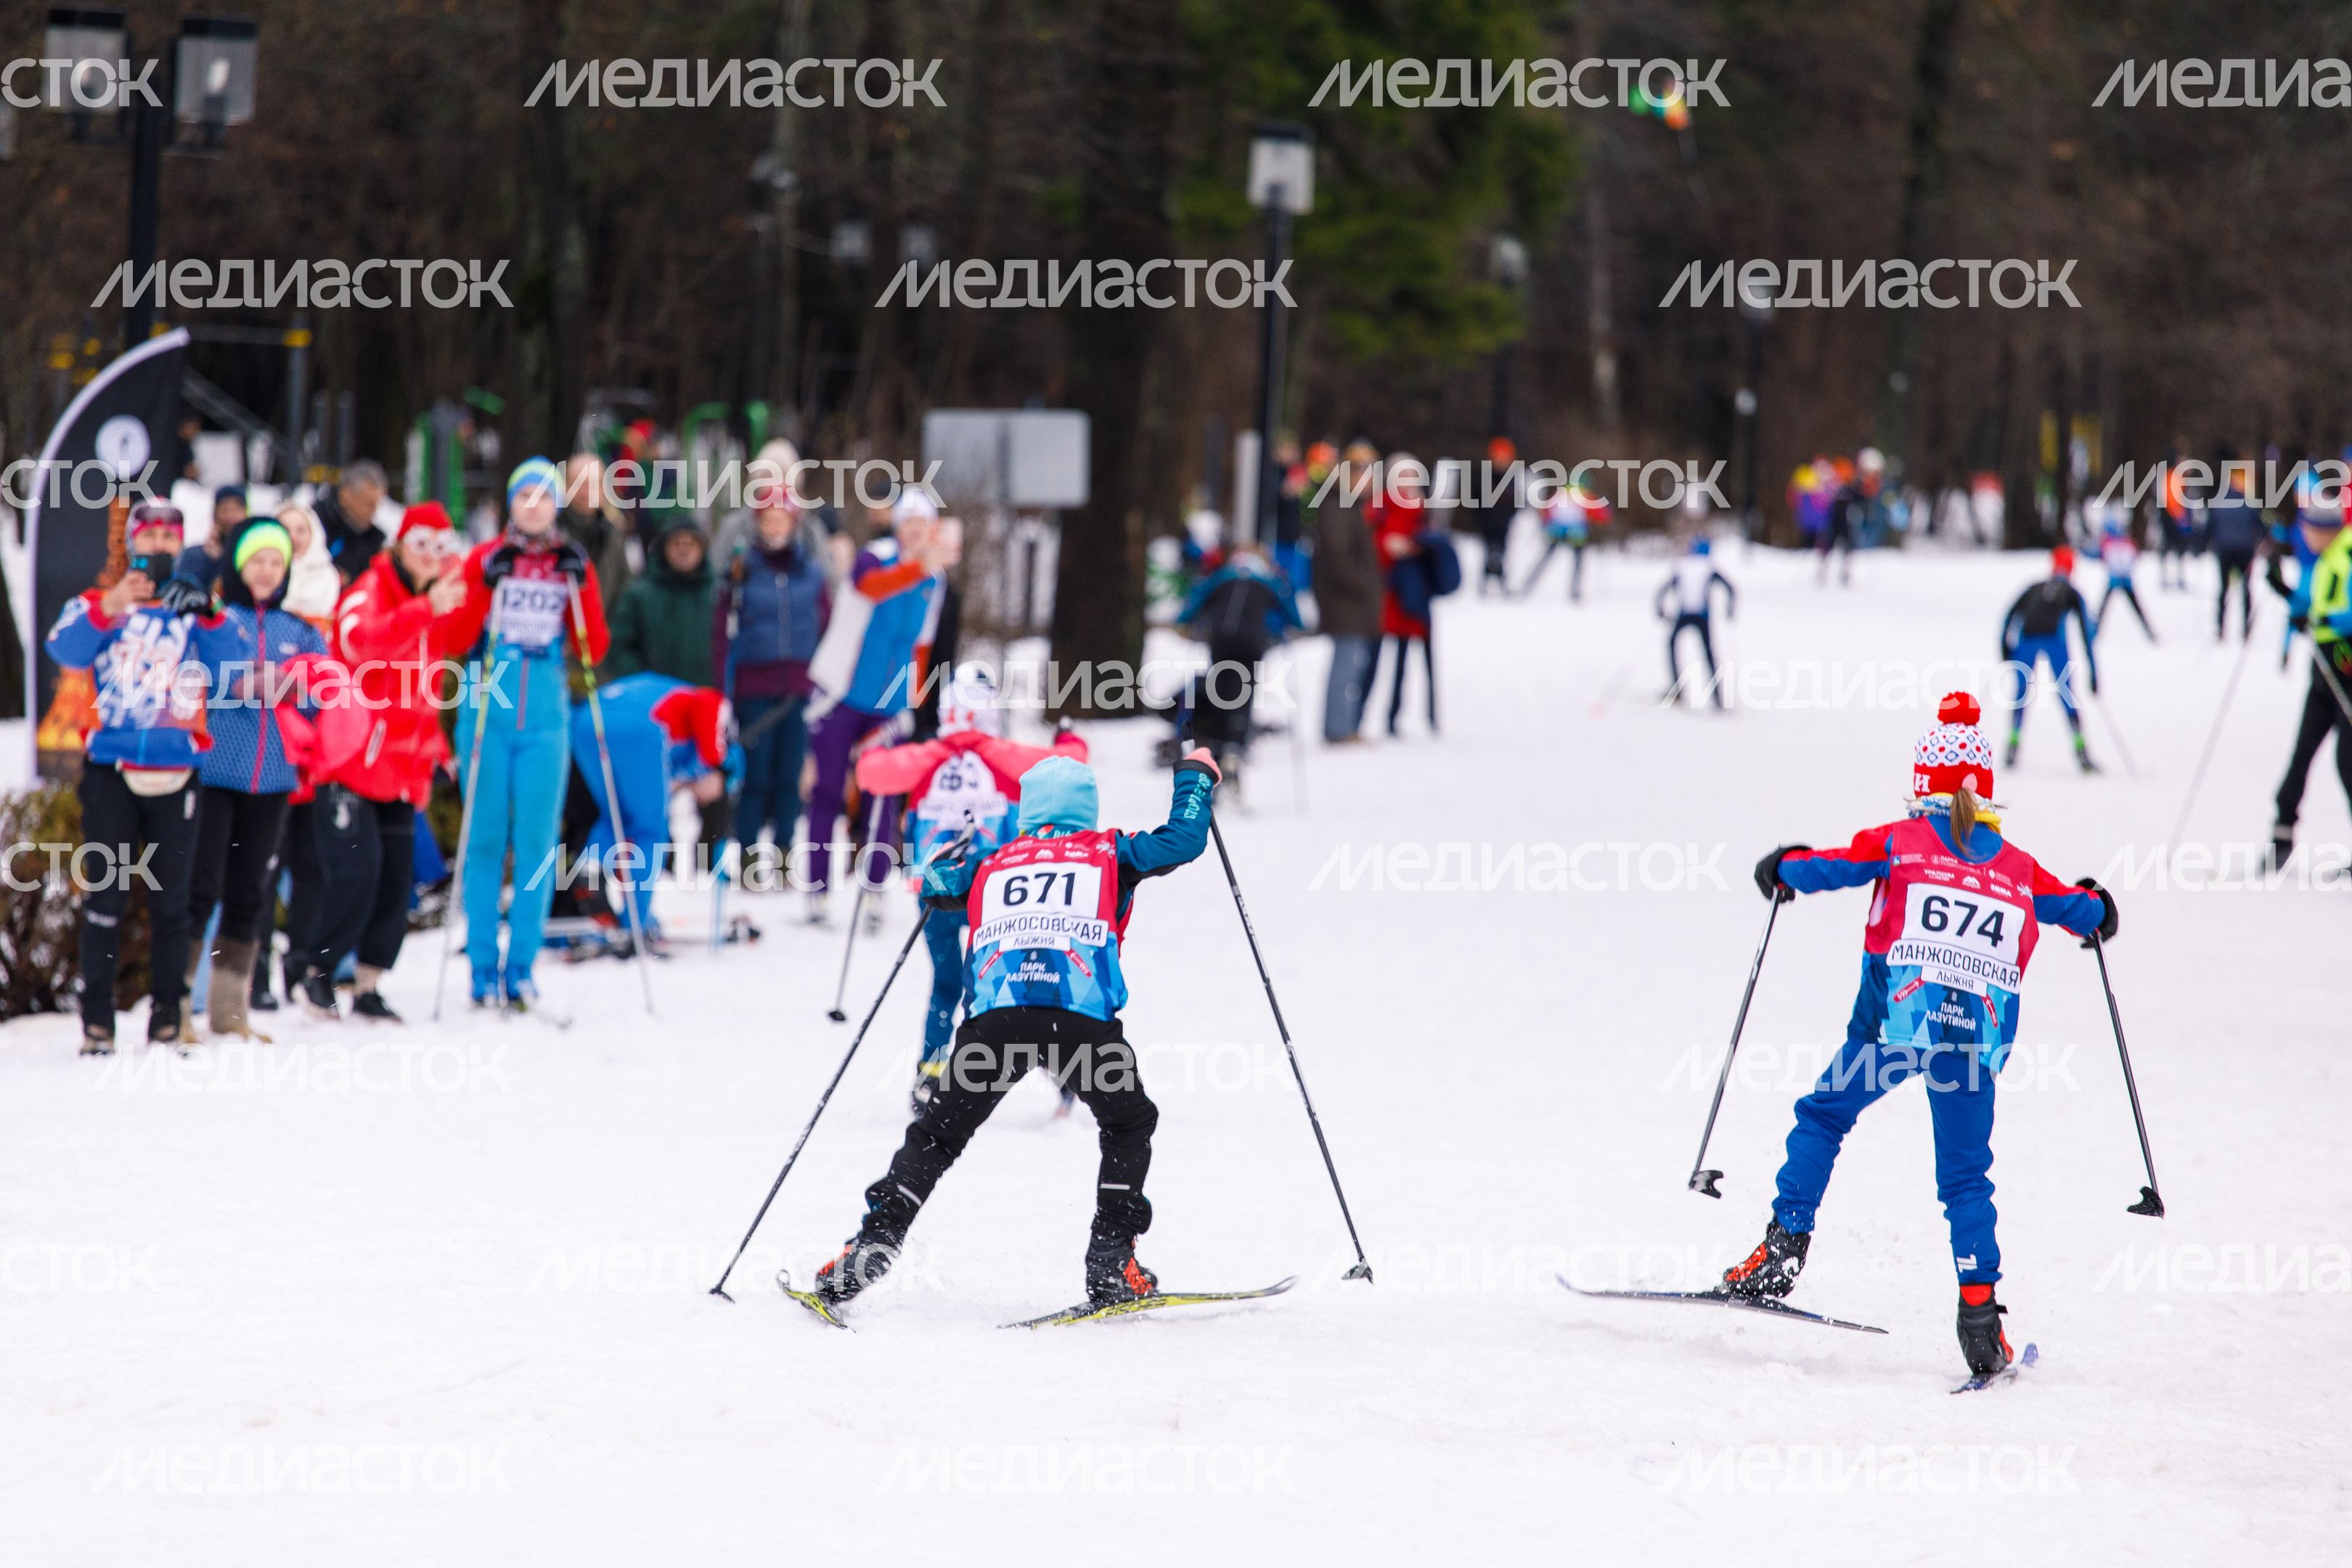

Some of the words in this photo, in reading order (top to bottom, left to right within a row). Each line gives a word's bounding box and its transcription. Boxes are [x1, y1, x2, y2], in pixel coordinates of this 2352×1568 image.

[1003, 872, 1076, 906] 671
[975, 916, 1102, 946] МАНЖОСОВСКАЯ
[1922, 895, 2004, 948] 674
[1013, 936, 1055, 947] ЛЫЖНЯ
[1020, 962, 1046, 972] ПАРК
[1892, 944, 2019, 988] МАНЖОСОВСКАЯ
[1936, 971, 1975, 990] ЛЫЖНЯ
[1926, 1009, 1976, 1032] ЛАЗУТИНОЙ
[1940, 1002, 1964, 1018] ПАРК
